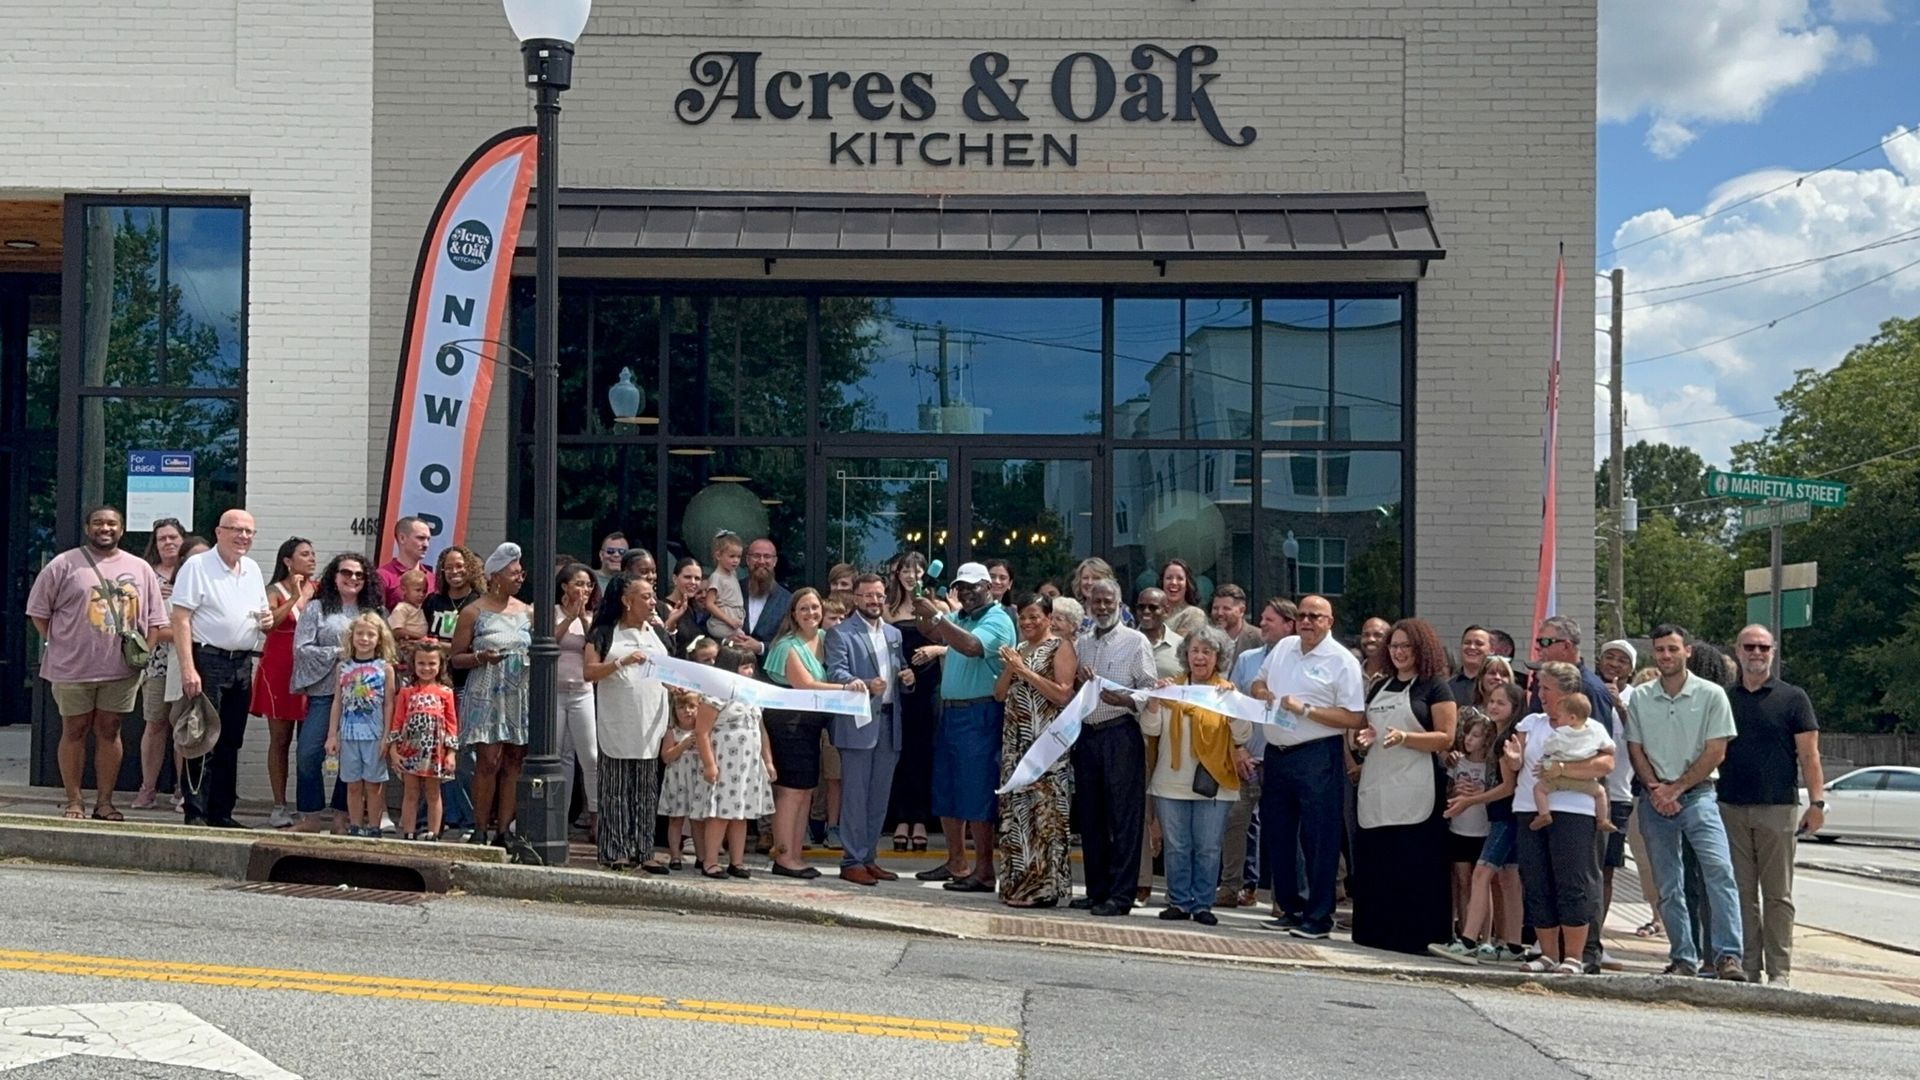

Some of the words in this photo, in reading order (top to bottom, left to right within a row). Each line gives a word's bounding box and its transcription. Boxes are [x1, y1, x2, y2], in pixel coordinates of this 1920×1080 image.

[674, 51, 937, 125] Acres
[963, 51, 1030, 122] &
[1051, 43, 1257, 147] Oak
[829, 132, 1077, 166] KITCHEN
[451, 227, 490, 245] Acres
[449, 241, 461, 254] &
[462, 242, 490, 263] Oak
[423, 294, 475, 428] NOW
[130, 454, 146, 464] For
[130, 463, 156, 473] Lease
[1731, 477, 1794, 499] MARIETTA
[1796, 483, 1842, 503] STREET
